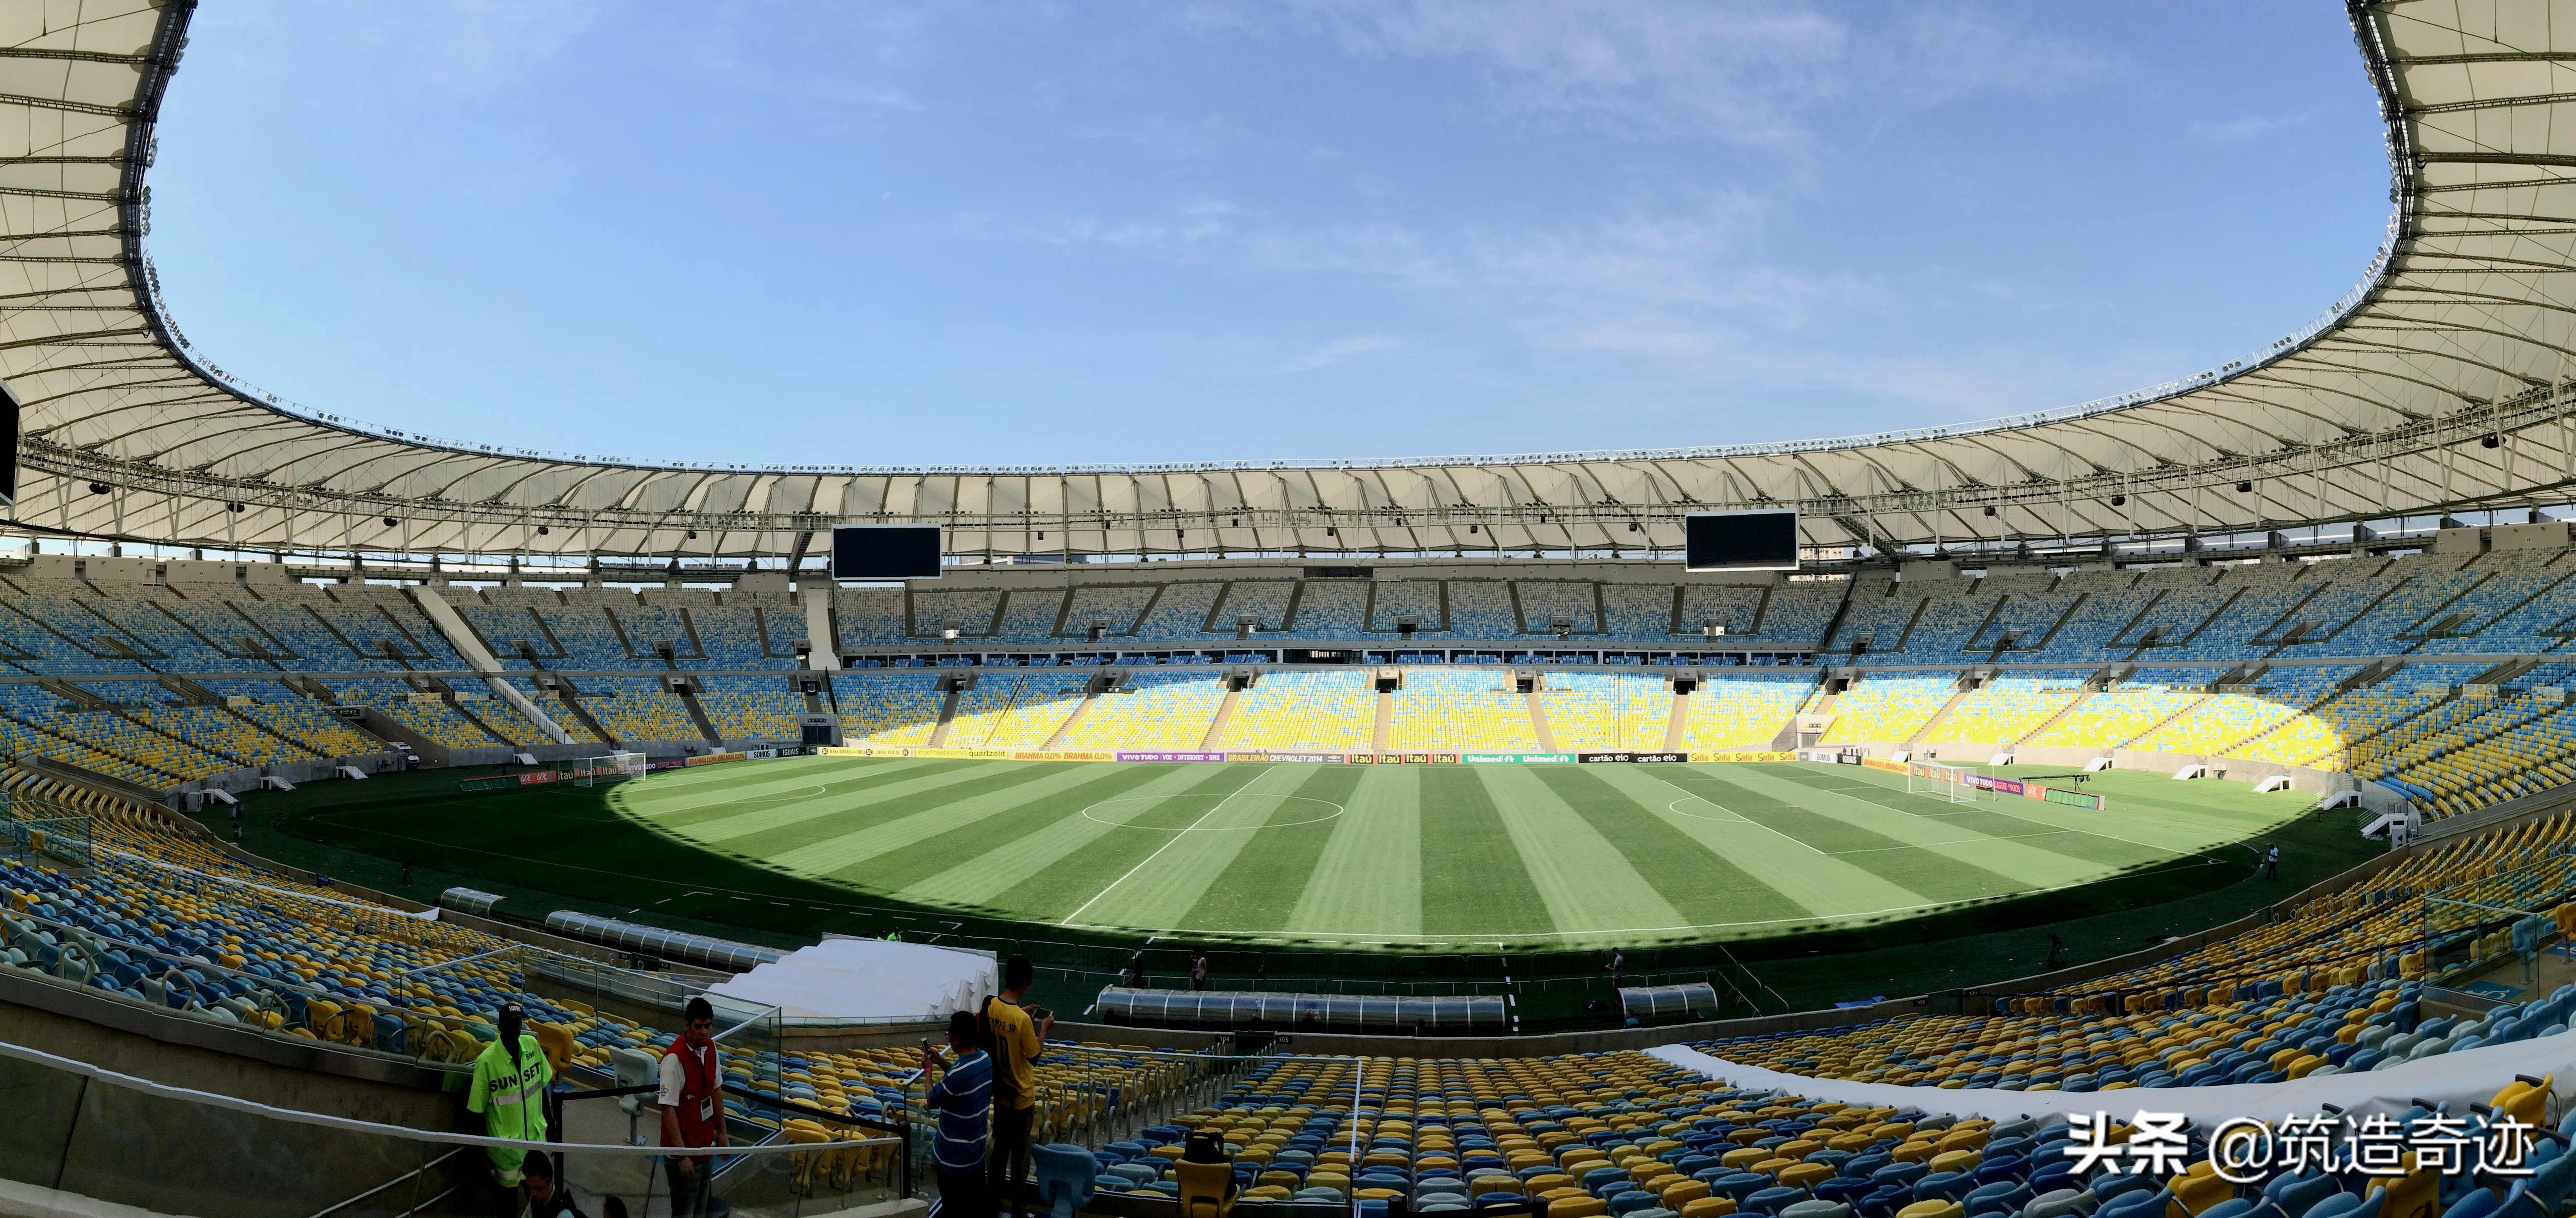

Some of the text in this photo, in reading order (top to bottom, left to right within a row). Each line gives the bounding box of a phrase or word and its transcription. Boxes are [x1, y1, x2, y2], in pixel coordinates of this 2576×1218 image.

[1228, 753, 1269, 761] BRASILEIRÃO
[1352, 754, 1372, 763] Itaú
[1379, 755, 1400, 763] Itaú
[1406, 754, 1427, 762] Itaú
[1434, 754, 1455, 763] Itaú
[1691, 753, 1708, 761] Sadia
[1714, 753, 1731, 761] Sadia
[1842, 755, 1857, 764] IGUAIS
[602, 765, 617, 775] Itaú
[1914, 765, 1925, 776] Itaú
[1929, 766, 1940, 778] Itaú
[521, 774, 531, 782] GOL
[536, 772, 547, 781] GOL
[558, 769, 574, 781] Itaú
[1967, 776, 1980, 785] VIVO
[1980, 778, 1993, 787] TUDO
[1994, 781, 2007, 790] LIGUE
[490, 1062, 541, 1092] SUN SET
